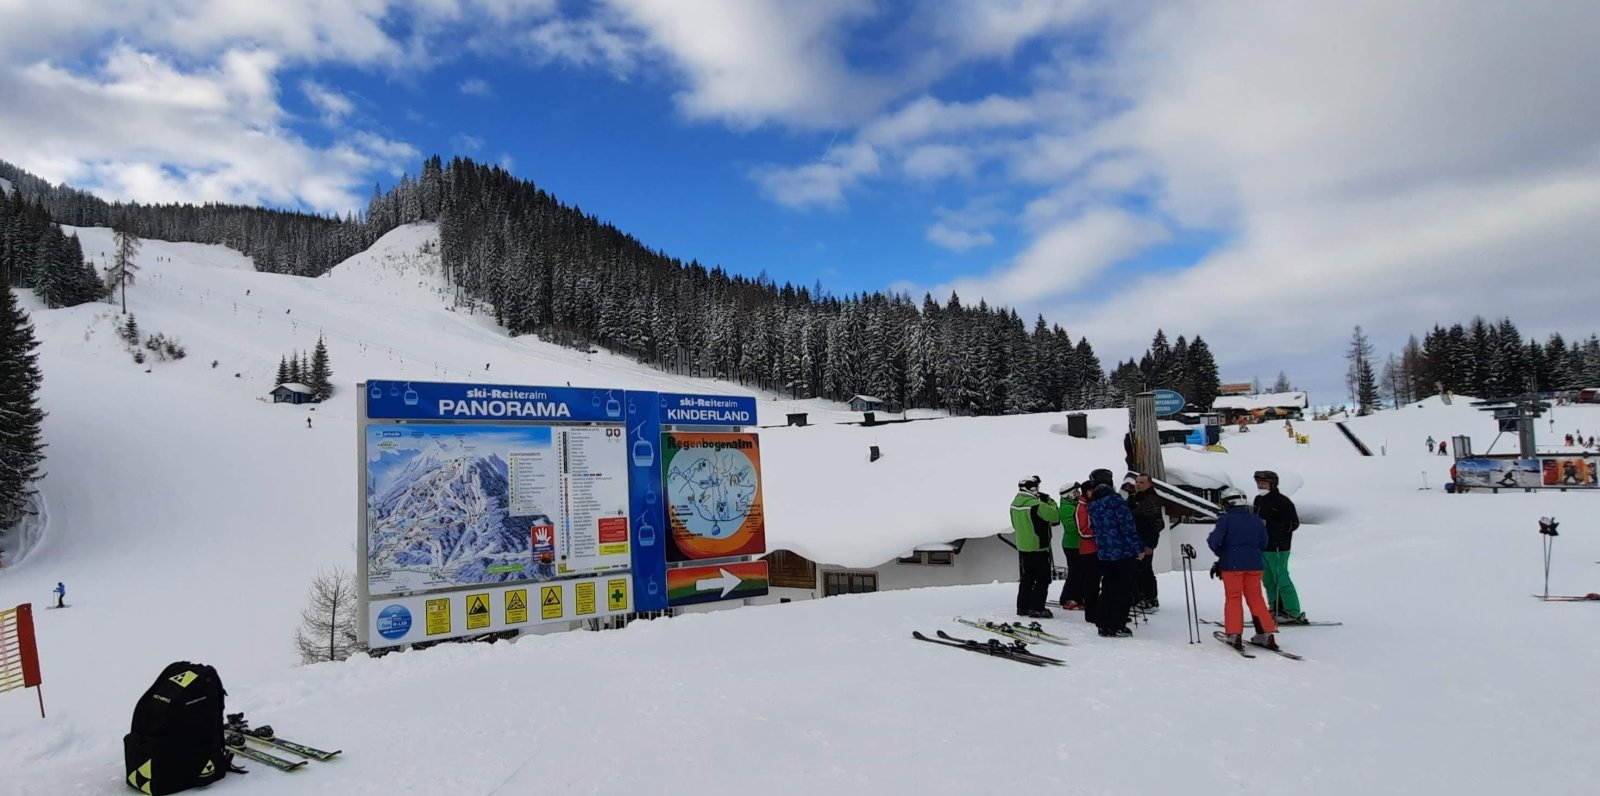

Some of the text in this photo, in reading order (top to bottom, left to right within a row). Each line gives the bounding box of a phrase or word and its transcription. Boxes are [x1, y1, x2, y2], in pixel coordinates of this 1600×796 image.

[466, 388, 547, 400] ski-Reiteralm
[438, 399, 571, 418] PANORAMA
[679, 397, 738, 408] ski-Reiteralm
[667, 408, 750, 421] KINDERLAND
[667, 436, 753, 452] Regenbogenalm
